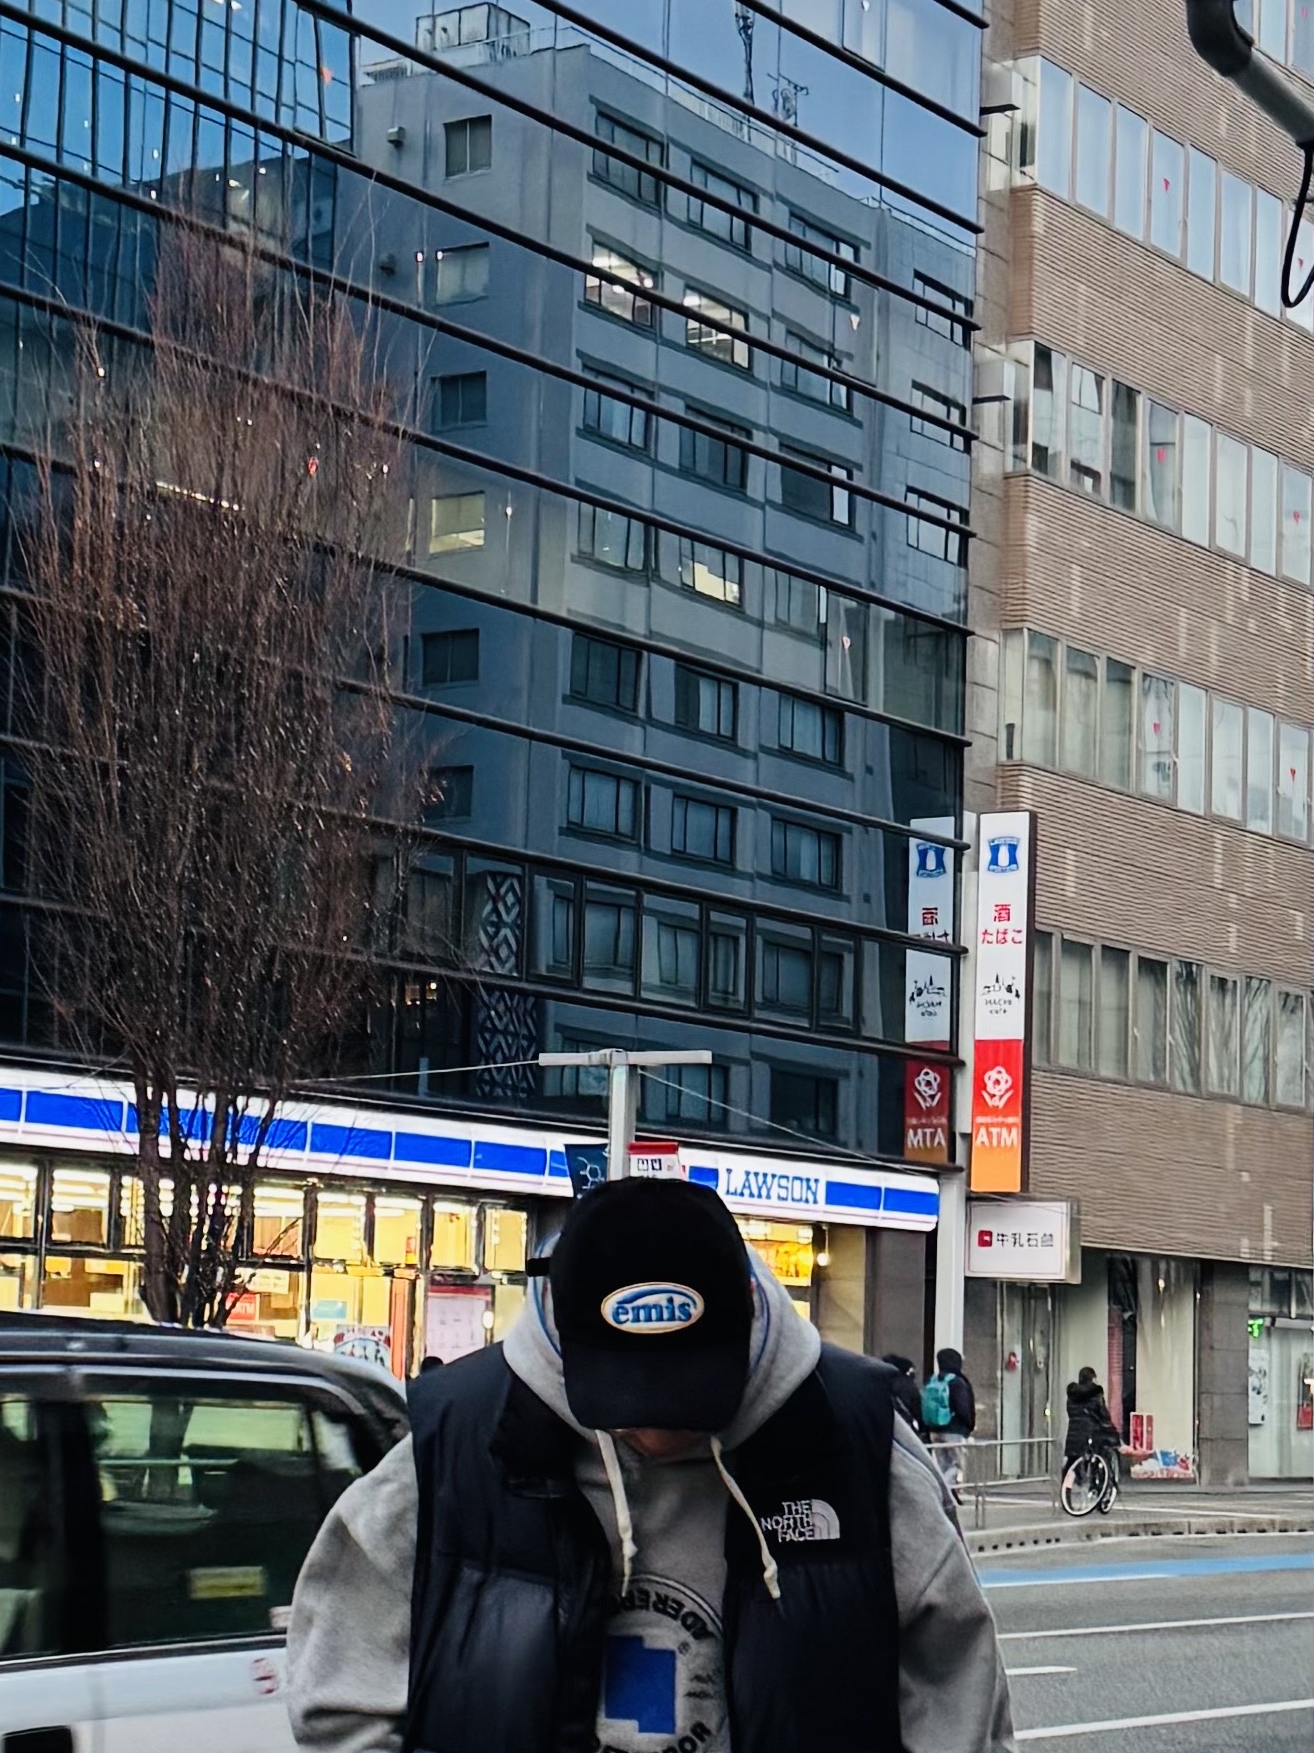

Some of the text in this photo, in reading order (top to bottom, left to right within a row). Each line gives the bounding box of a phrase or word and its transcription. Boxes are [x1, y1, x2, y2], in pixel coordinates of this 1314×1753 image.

[994, 904, 1011, 923] 酒
[981, 928, 1023, 945] たばこ
[975, 1126, 1018, 1148] ATM
[725, 1168, 820, 1205] LAWSON
[611, 1296, 693, 1325] emis
[782, 1500, 811, 1516] THE
[761, 1510, 813, 1532] NORTH
[777, 1527, 815, 1543] FACE
